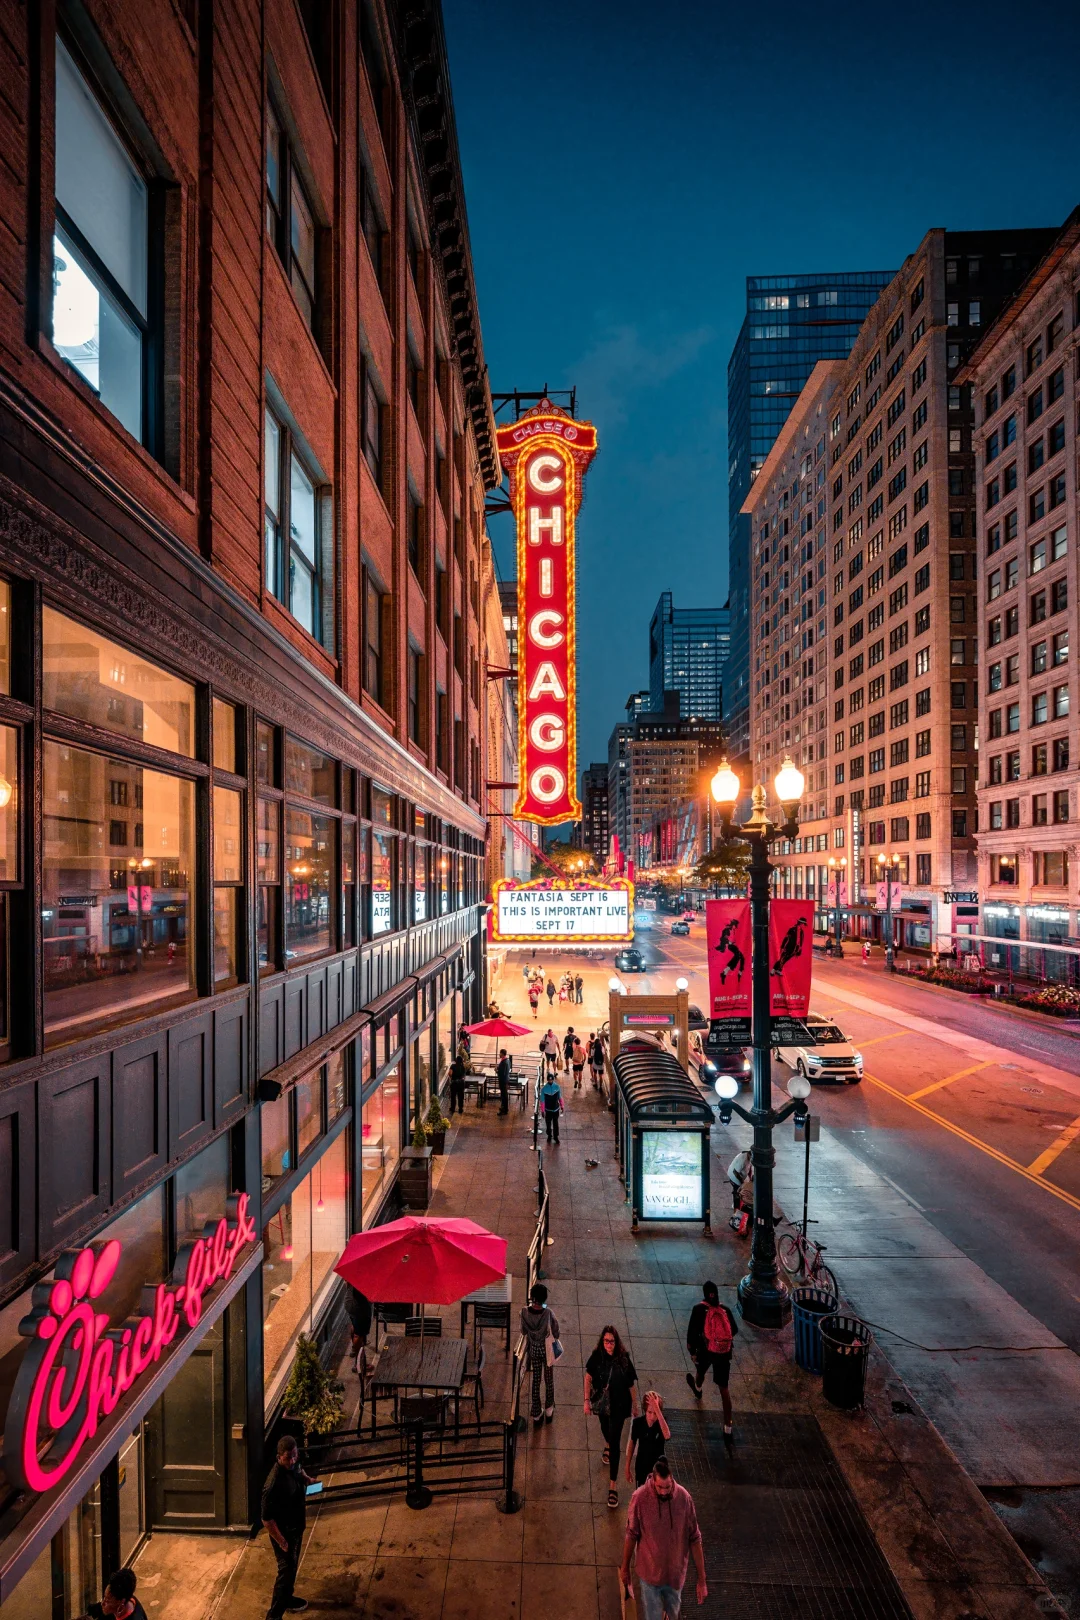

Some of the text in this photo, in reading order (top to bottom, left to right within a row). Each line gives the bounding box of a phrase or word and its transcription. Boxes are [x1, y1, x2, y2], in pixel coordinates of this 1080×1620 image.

[513, 420, 563, 442] CHASE
[528, 454, 566, 804] CHICAGO
[510, 892, 608, 902] FANTASIA SEPT 16
[502, 906, 626, 916] THIS IS IMPORTANT LIVE
[536, 920, 575, 930] SEPT 17
[645, 1195, 689, 1204] VAN GOGH
[22, 1192, 257, 1493] Chick-fil-A
